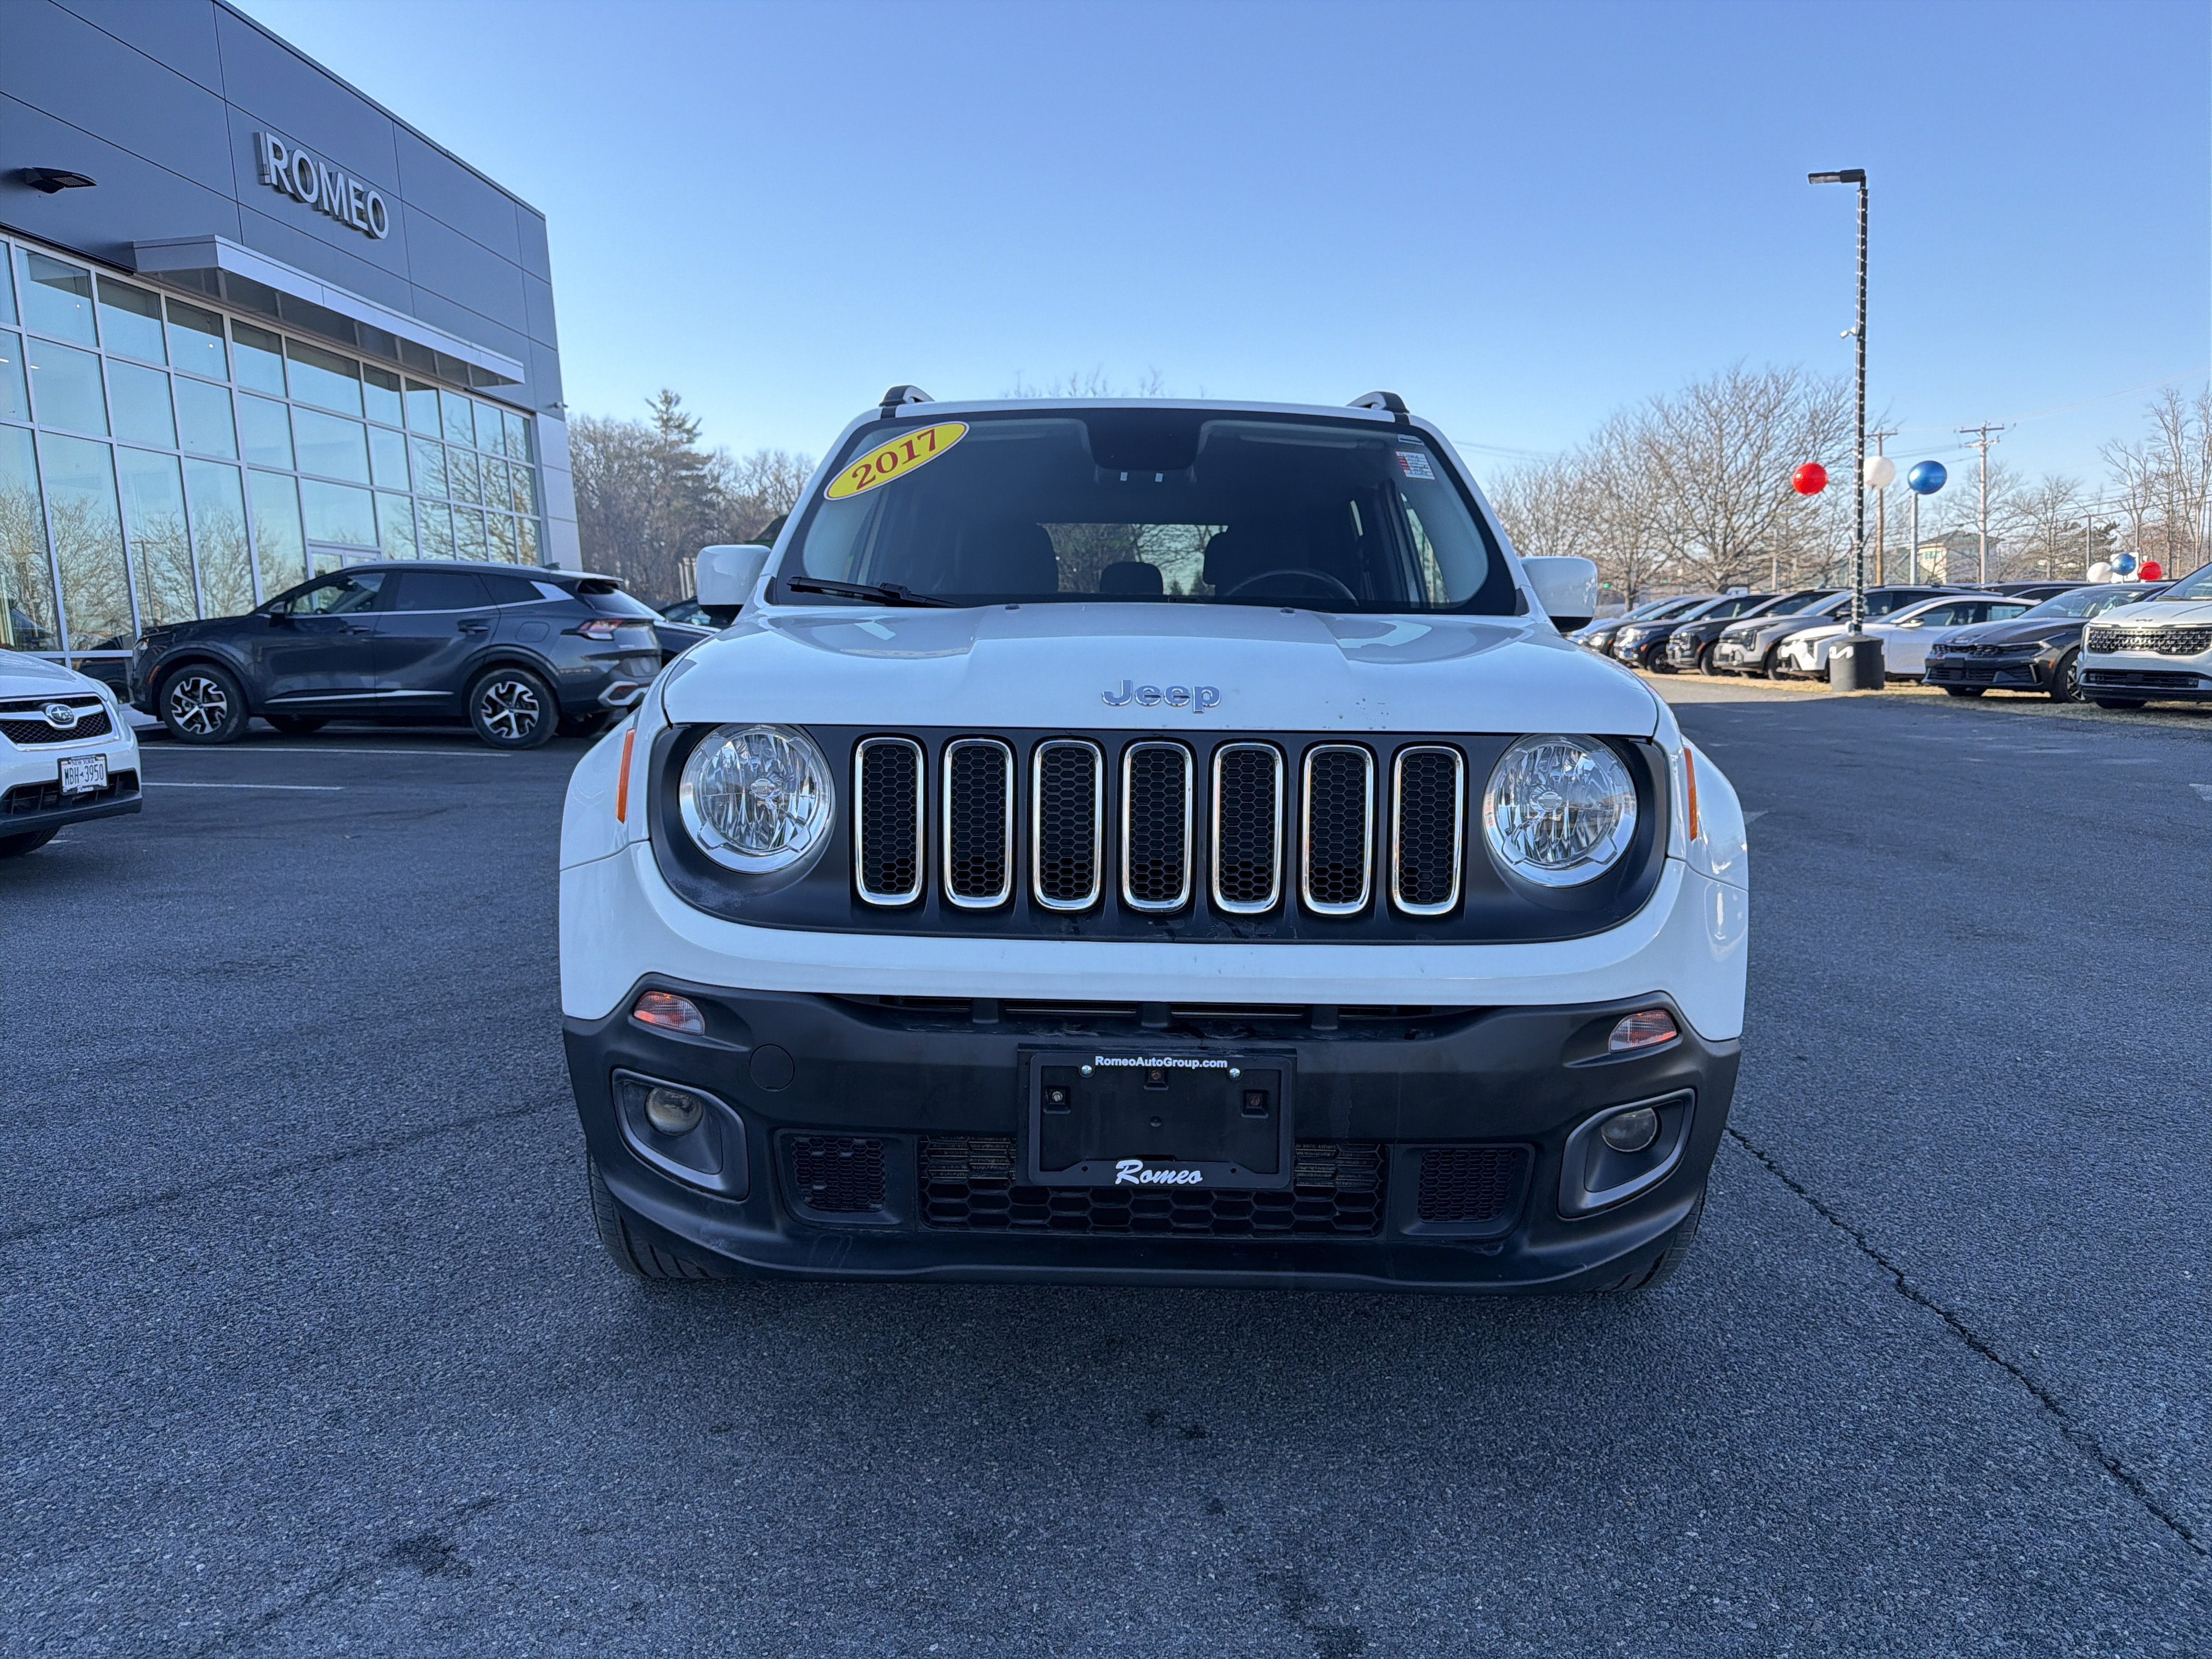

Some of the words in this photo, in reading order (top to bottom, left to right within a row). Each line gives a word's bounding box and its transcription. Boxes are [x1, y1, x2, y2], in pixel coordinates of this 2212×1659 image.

[260, 131, 389, 239] ROMEO
[851, 428, 936, 490] 2017
[1102, 680, 1221, 713] Jeep
[1095, 1056, 1228, 1069] RomeoAutoGroup.com
[1115, 1159, 1203, 1184] Romeo
